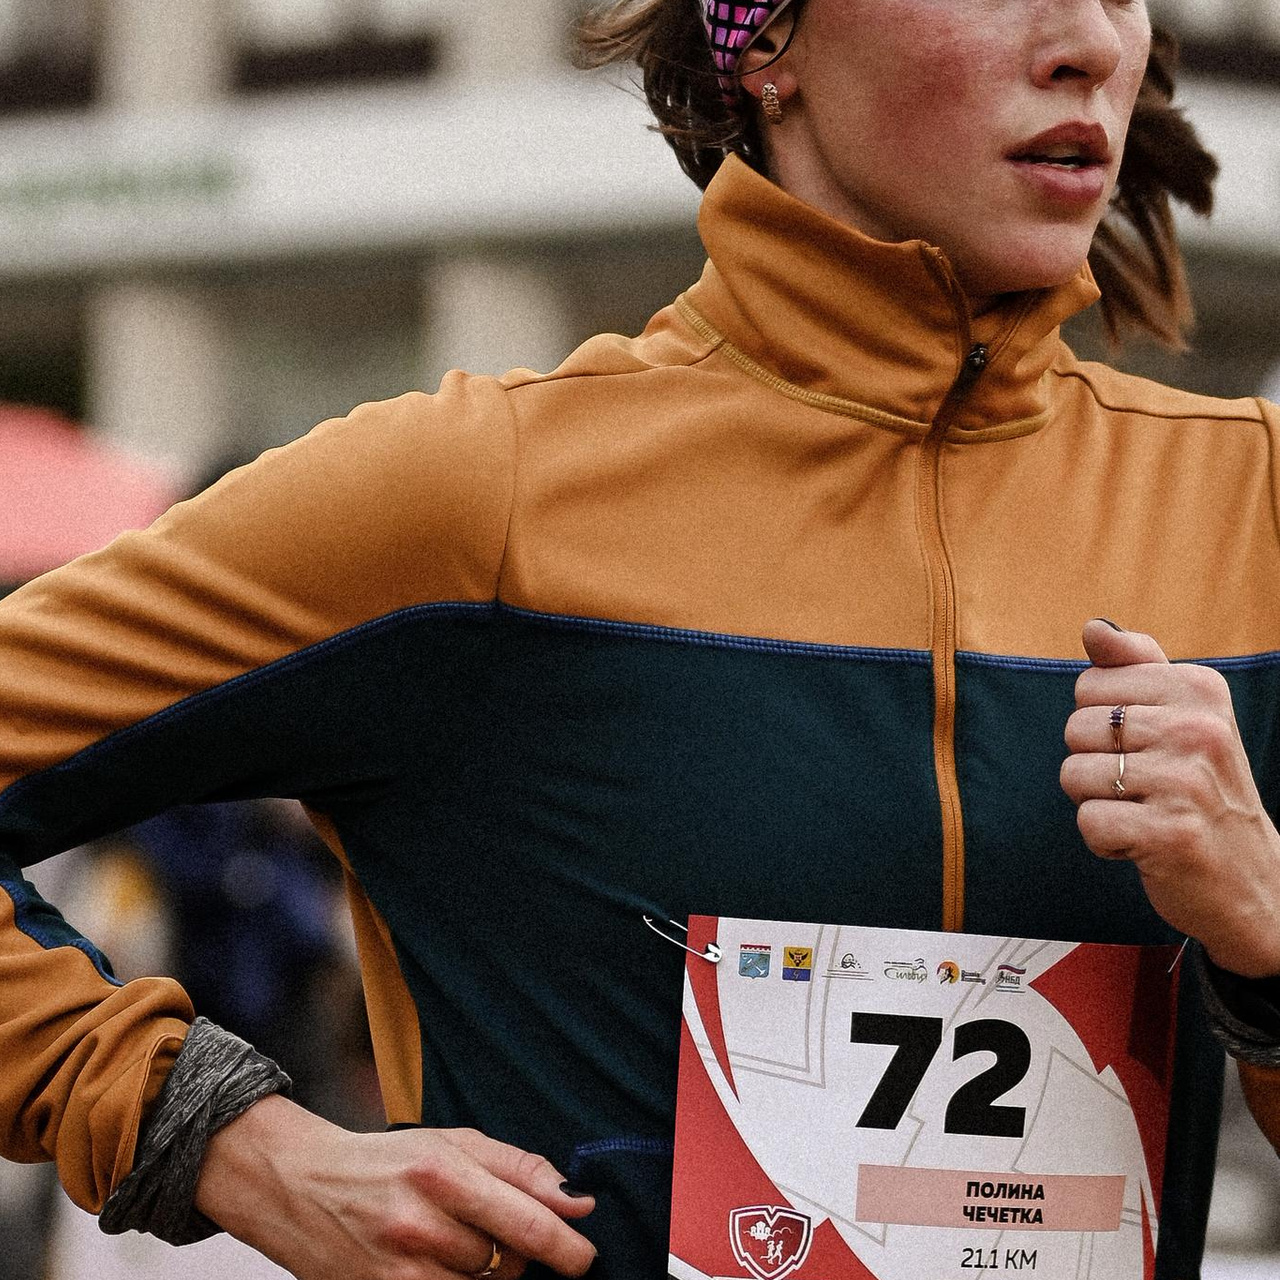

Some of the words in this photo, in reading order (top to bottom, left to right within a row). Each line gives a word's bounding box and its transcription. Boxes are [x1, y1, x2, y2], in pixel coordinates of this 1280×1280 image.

[850, 1012, 1031, 1138] 72
[966, 1181, 1045, 1200] ПОЛИНА
[963, 1205, 1043, 1224] ЧЕЧЕТКА
[961, 1248, 999, 1269] 21.1
